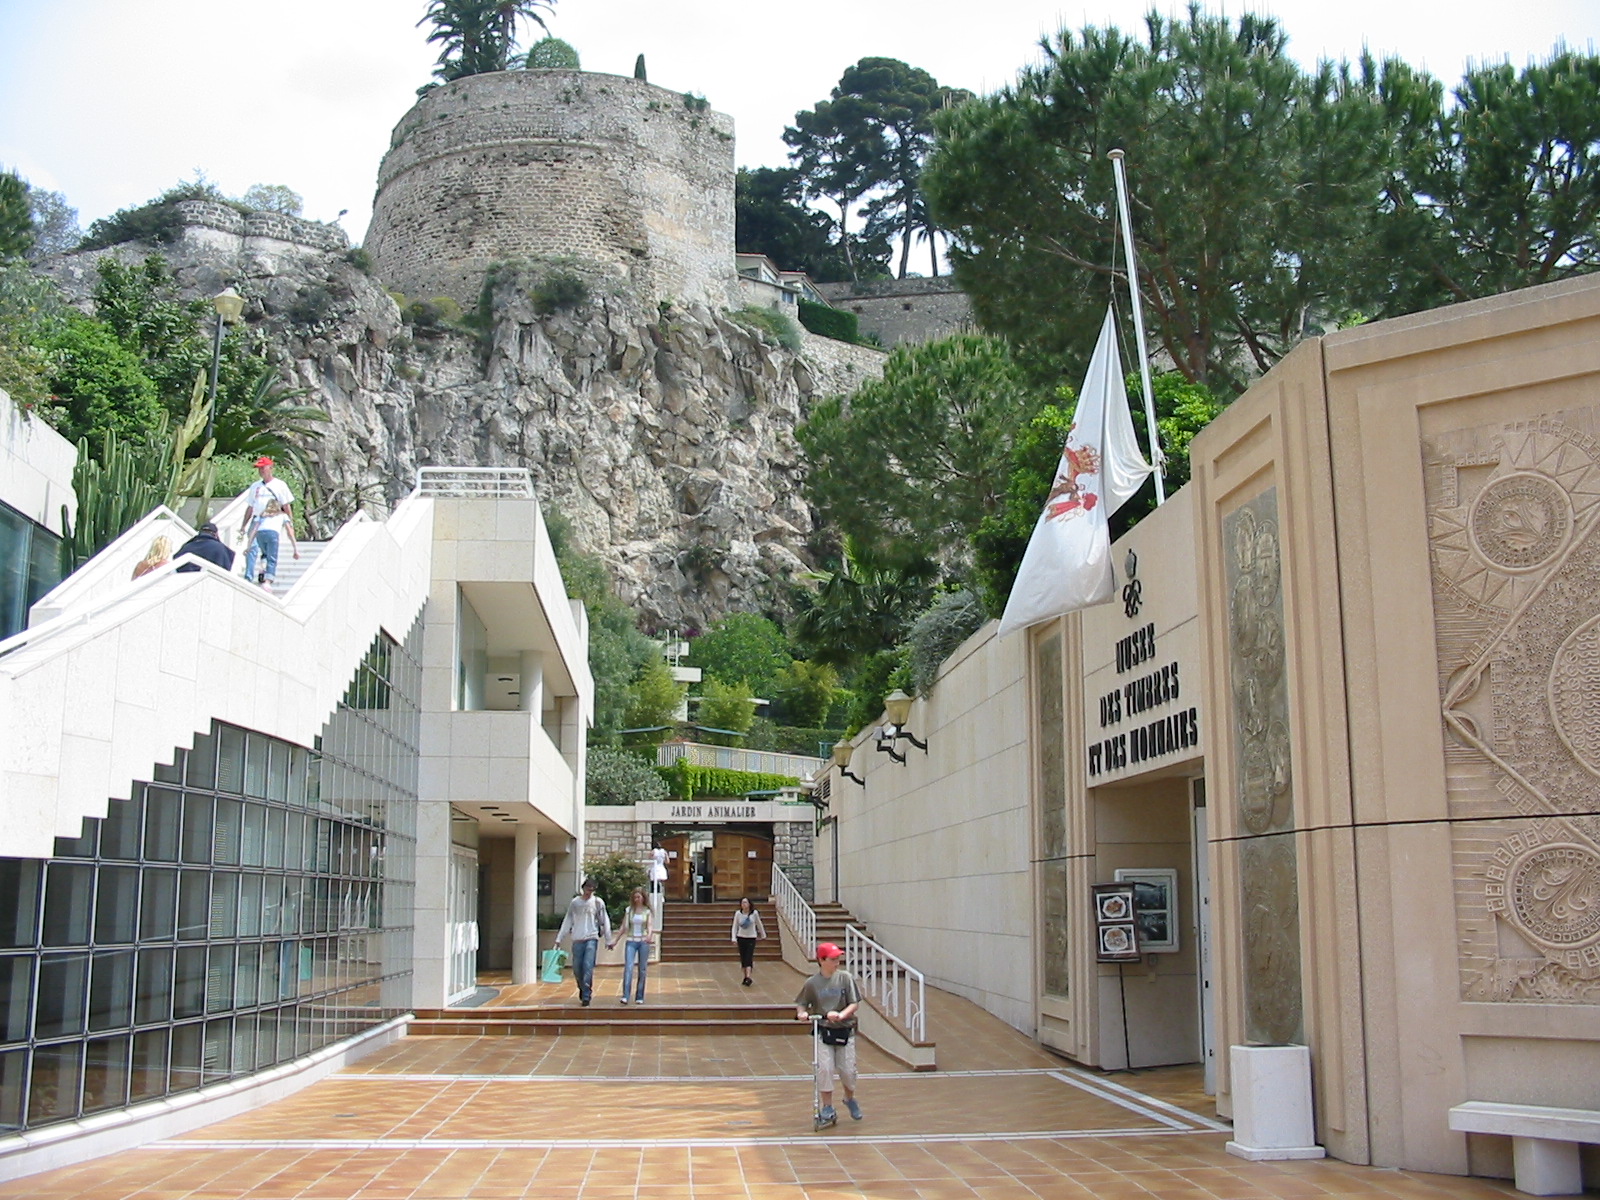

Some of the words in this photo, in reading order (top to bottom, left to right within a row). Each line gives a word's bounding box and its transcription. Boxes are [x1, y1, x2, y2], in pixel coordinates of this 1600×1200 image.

[1100, 689, 1121, 727] DES
[1124, 662, 1179, 717] TIMBRES
[1088, 742, 1102, 775] ET
[1105, 734, 1126, 771] DES
[1130, 707, 1198, 763] MONNAIES
[671, 806, 702, 817] JARDIN
[708, 806, 756, 817] ANIMALIER
